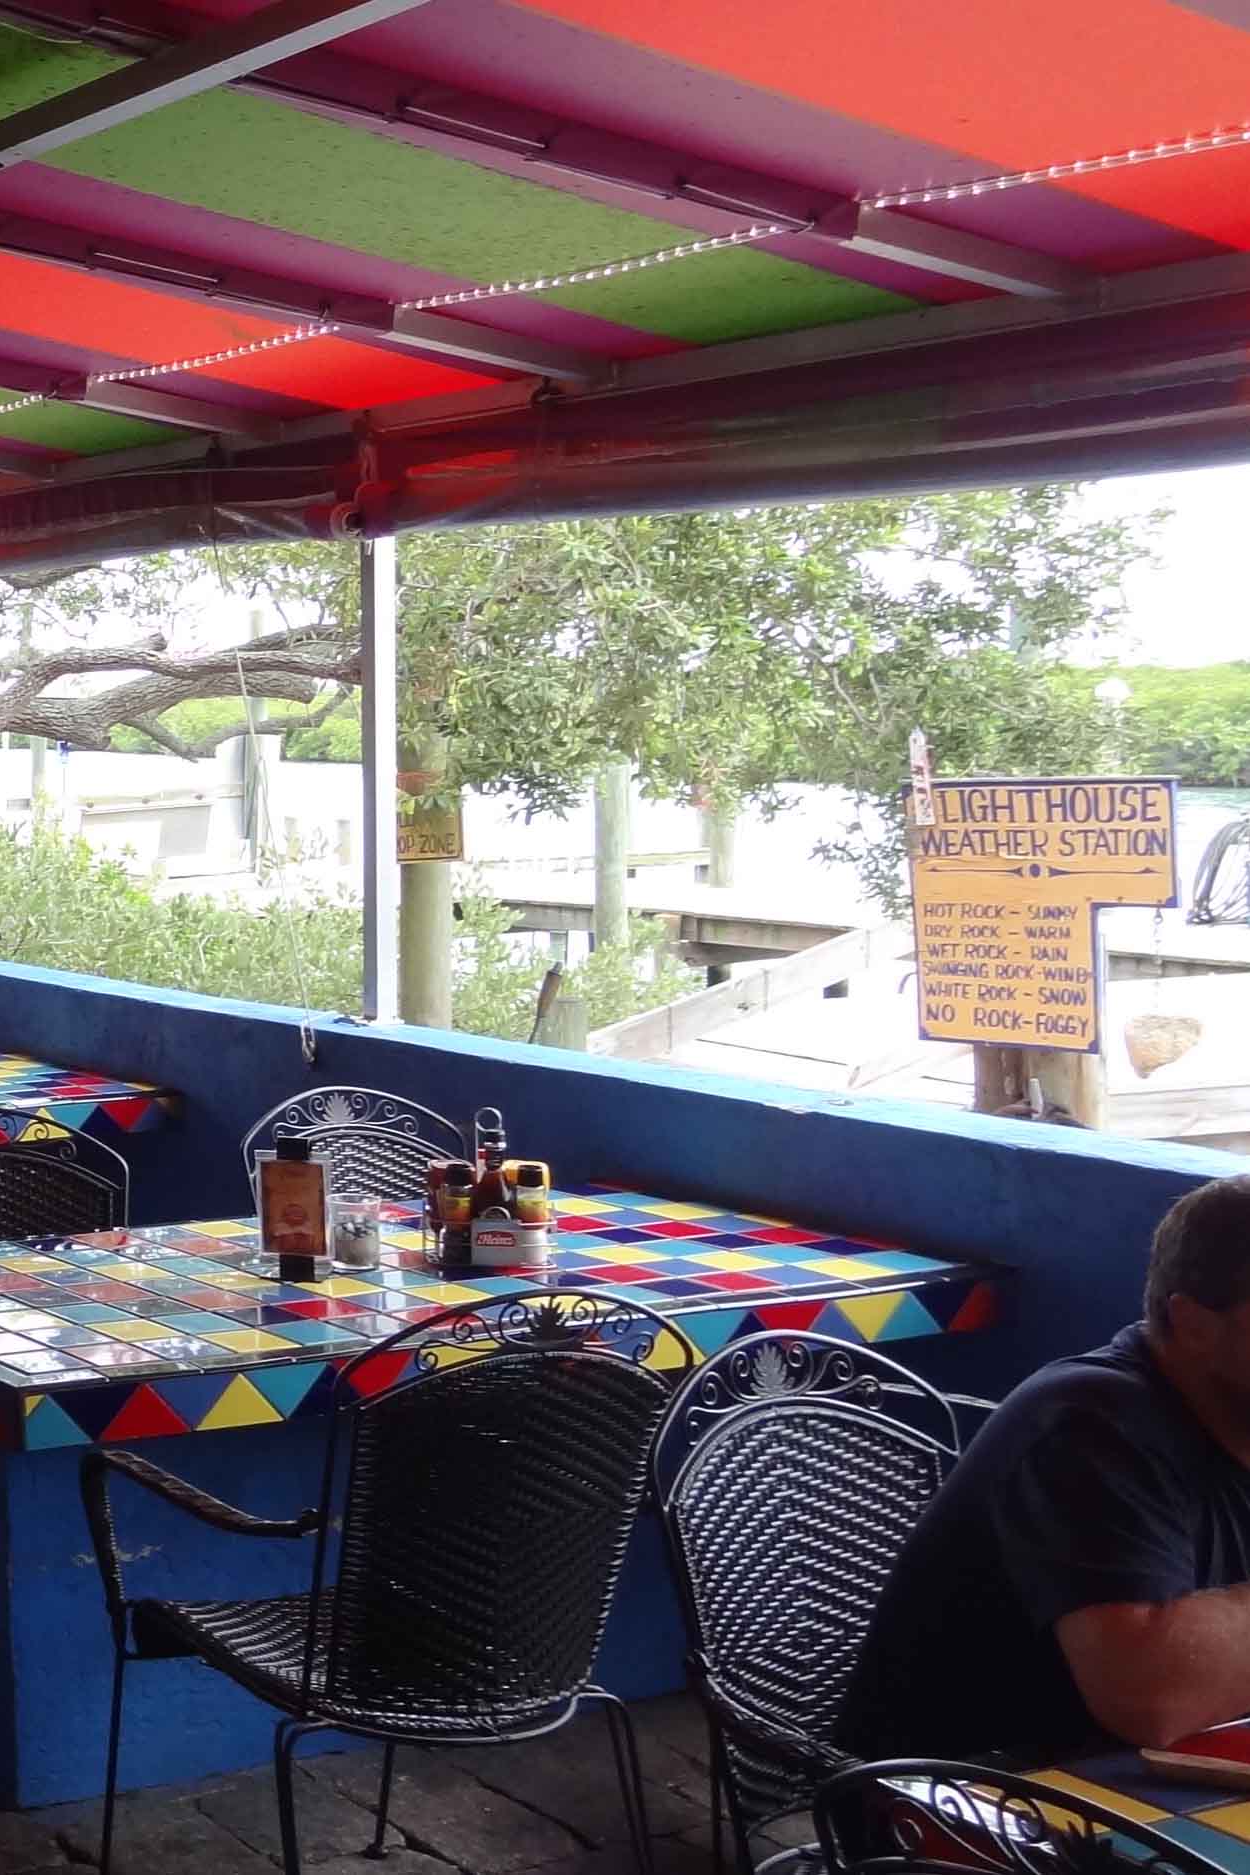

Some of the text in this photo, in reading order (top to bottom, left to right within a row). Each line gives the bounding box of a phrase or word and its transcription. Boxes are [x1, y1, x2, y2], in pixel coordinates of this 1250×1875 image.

[939, 786, 1162, 823] LIGHTHOUSE
[398, 834, 414, 853] OP
[921, 828, 1167, 857] WEATHER STATION
[924, 903, 1078, 920] HOT ROCK SUNNY
[924, 924, 1071, 939] DRY ROCK WARM
[964, 944, 1008, 960] ROCK
[1030, 945, 1069, 961] RAIN
[995, 964, 1035, 981] ROCK
[924, 980, 1087, 1006] WHITE ROCK SNOW
[926, 1003, 956, 1022] NO
